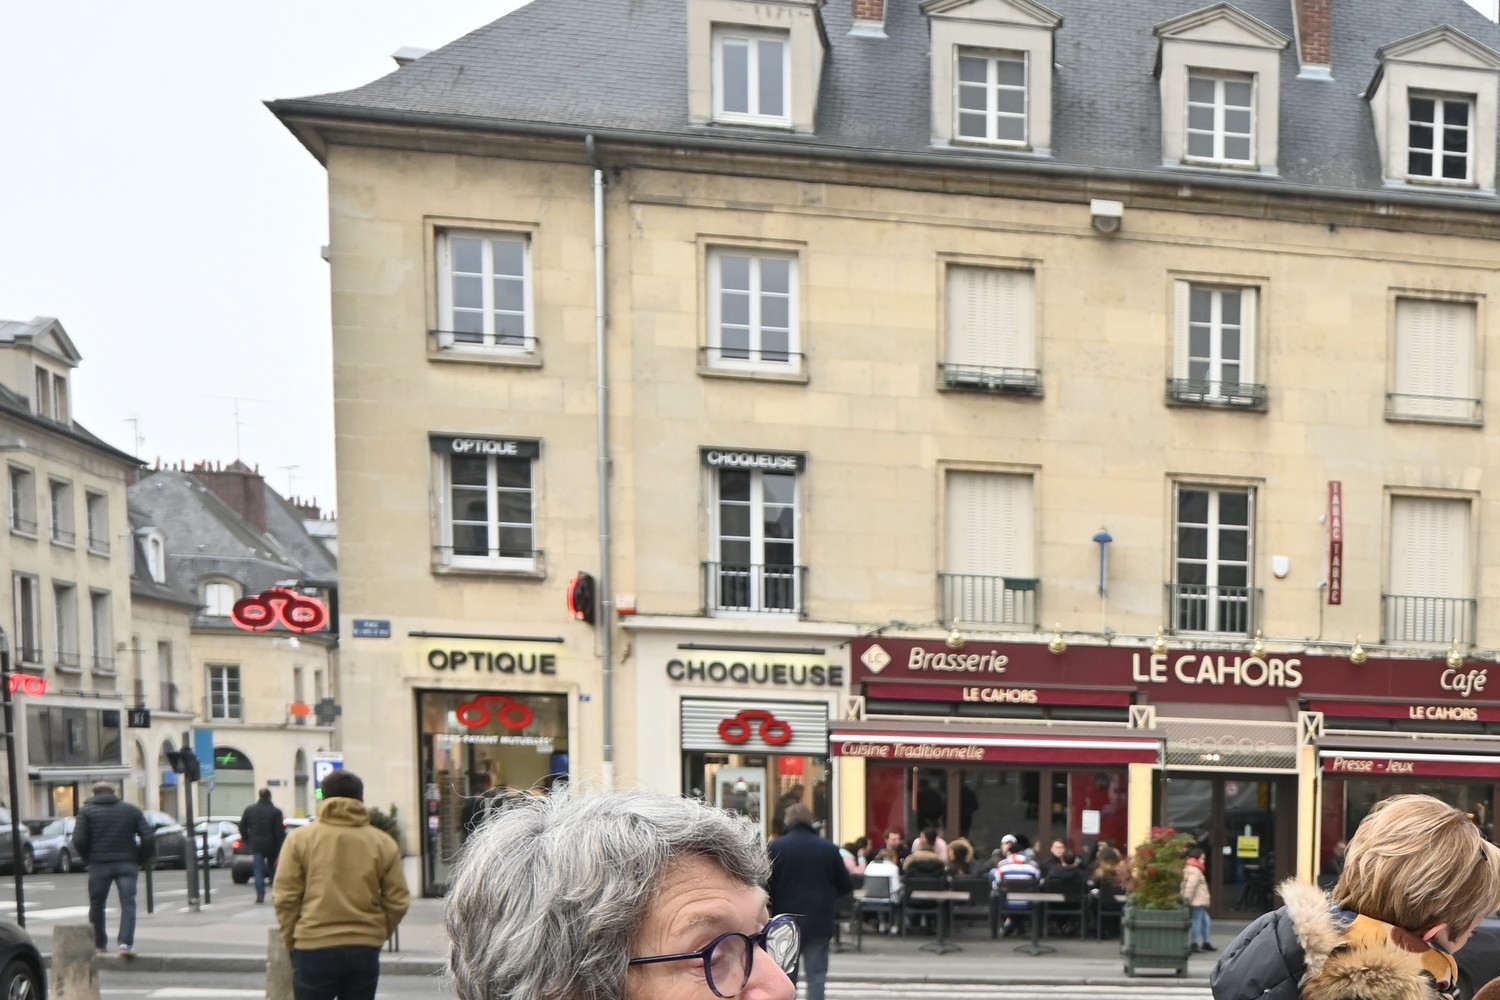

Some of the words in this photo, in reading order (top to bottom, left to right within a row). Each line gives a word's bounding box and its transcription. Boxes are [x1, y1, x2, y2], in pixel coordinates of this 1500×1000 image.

[452, 437, 518, 456] OPTIQUE
[707, 450, 798, 471] CHOQUEUSE
[1331, 482, 1341, 540] TABAC
[1331, 543, 1340, 602] TABAC
[427, 647, 558, 677] OPTIQUE
[666, 658, 844, 687] CHOQUEUSE
[907, 646, 1009, 674] Brasserie
[1132, 652, 1168, 683] LE
[1174, 656, 1303, 689] CAHORS
[963, 687, 979, 702] LE
[981, 687, 1038, 704] CAHORS
[1439, 667, 1487, 698] Café
[1409, 706, 1425, 720] LE
[1427, 706, 1478, 722] CAHORS
[840, 741, 890, 758] Cuisine
[892, 742, 986, 761] Traditionnelle
[1333, 755, 1373, 774] Presse
[1386, 758, 1415, 775] Jeux
